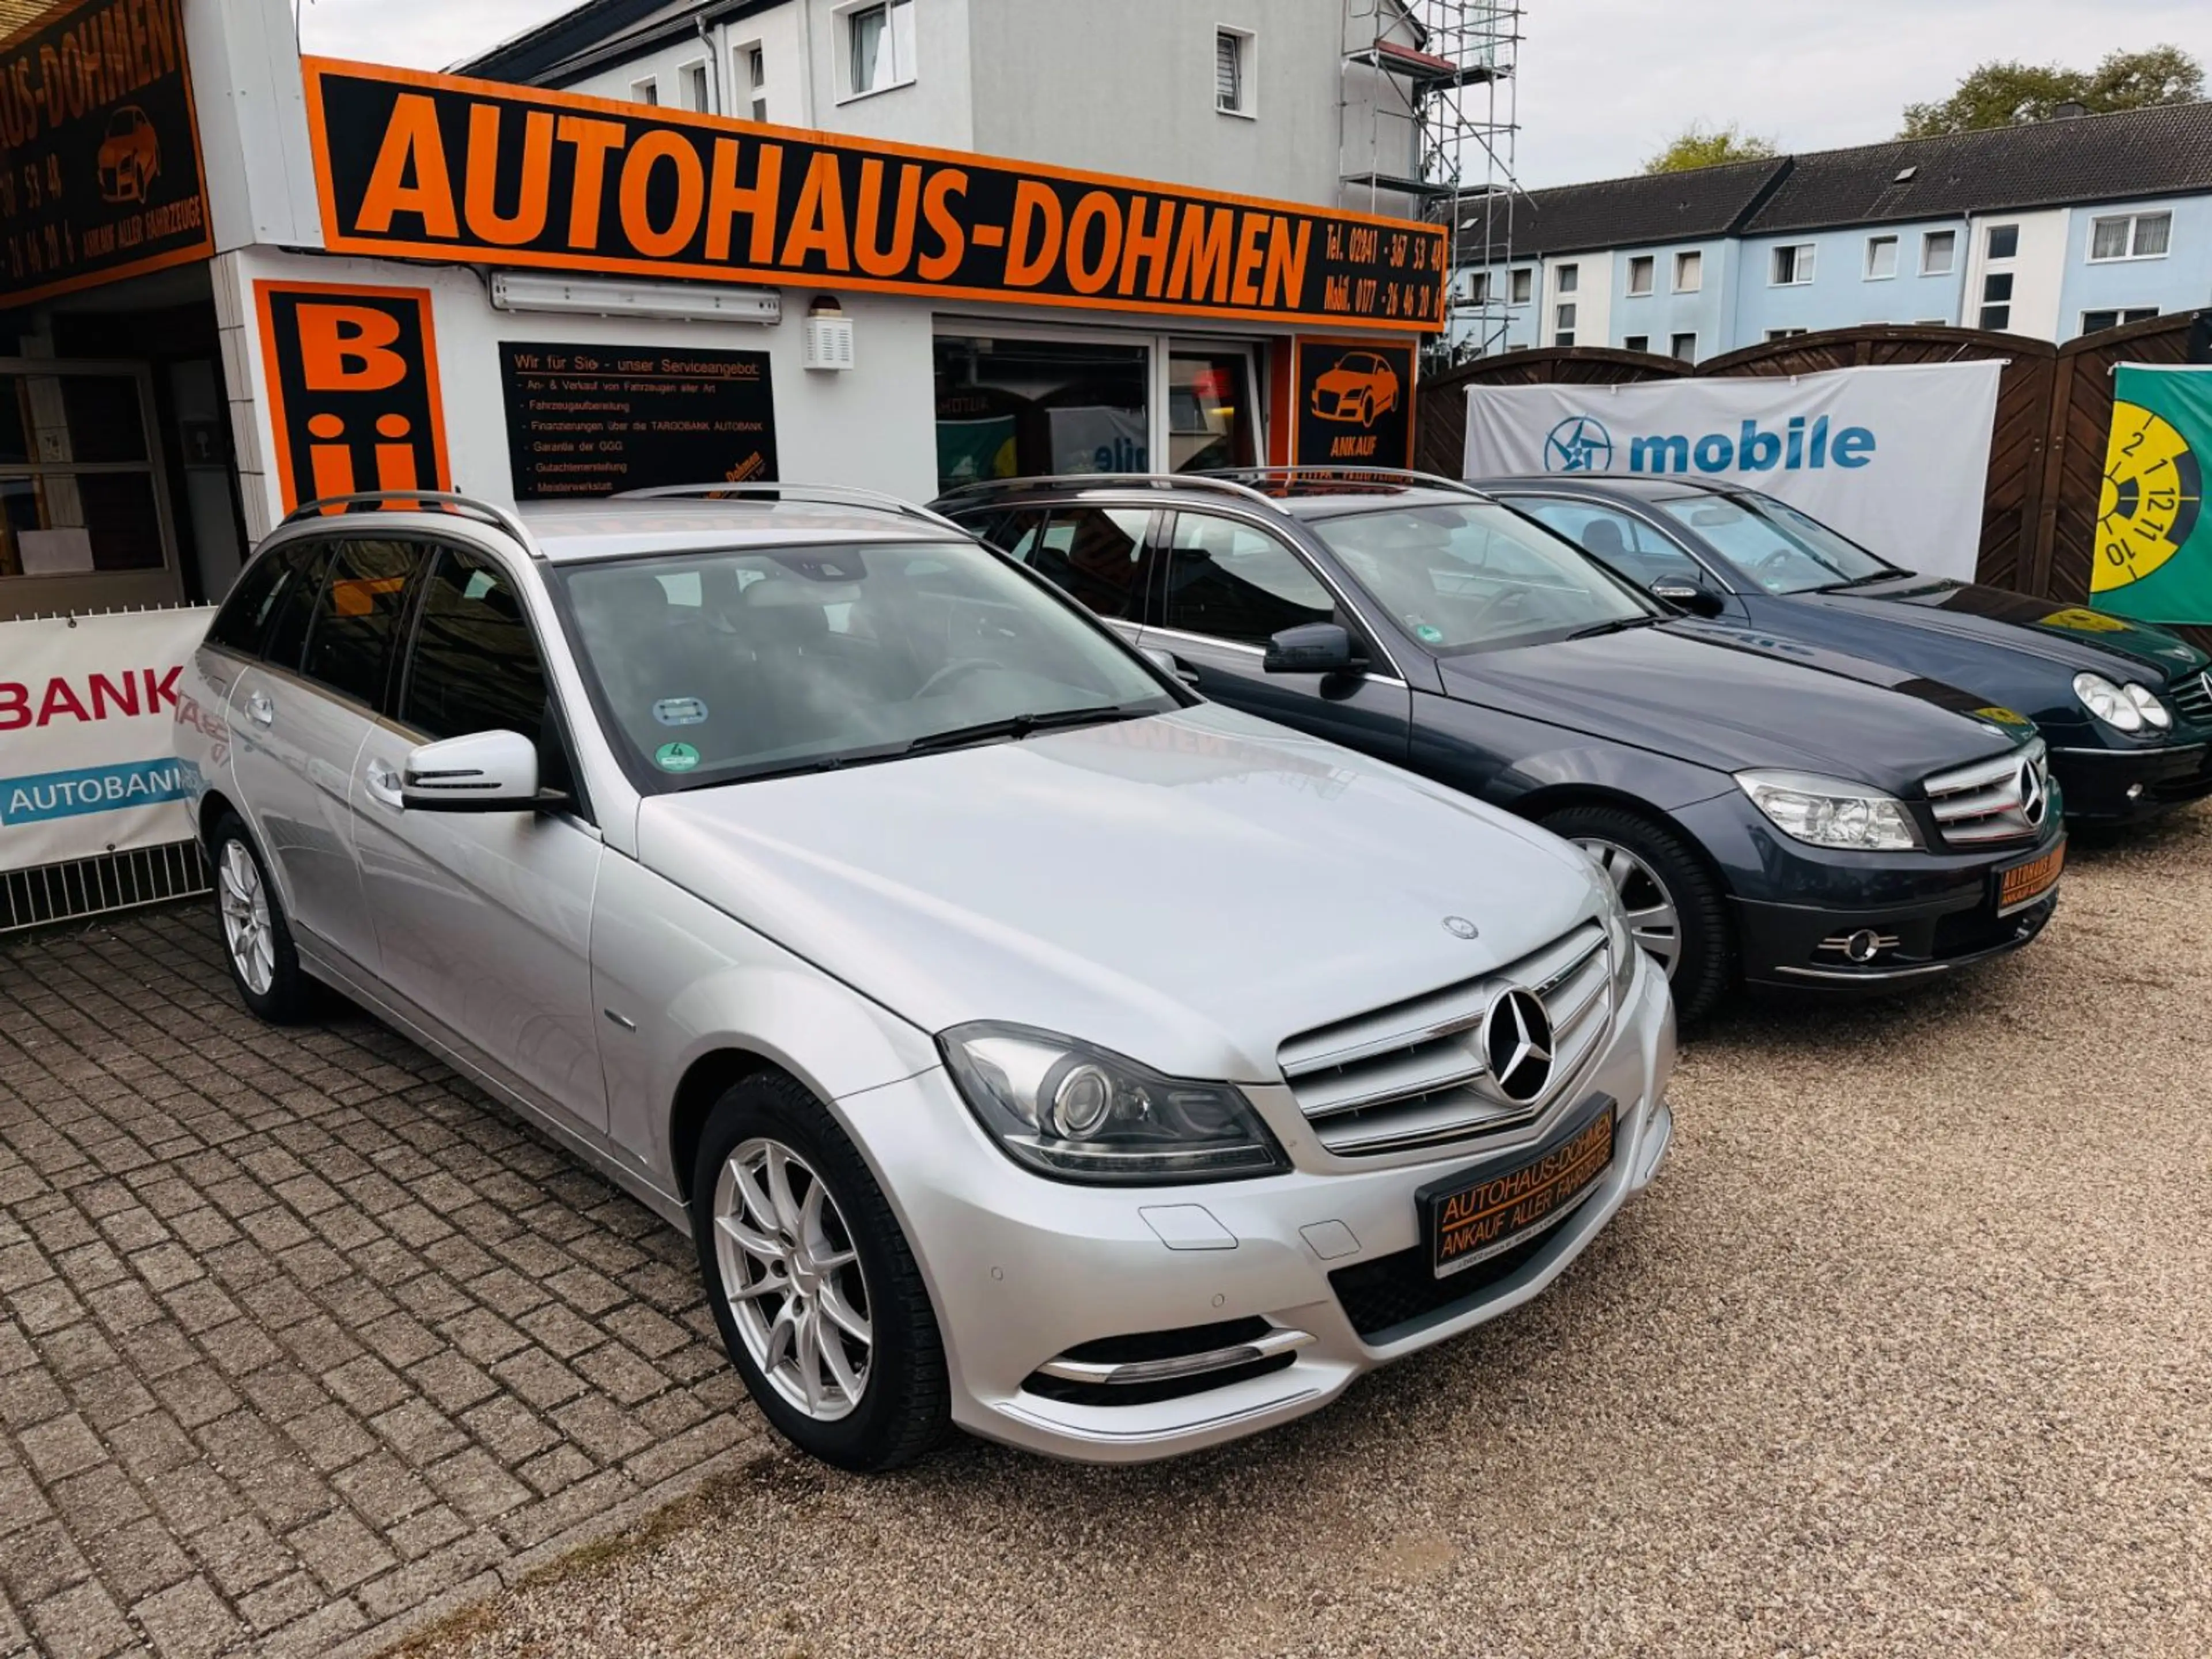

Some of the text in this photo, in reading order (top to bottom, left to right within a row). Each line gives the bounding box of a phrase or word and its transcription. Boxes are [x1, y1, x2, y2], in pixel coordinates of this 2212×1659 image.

[355, 92, 1312, 309] AUTOHAUS-DOHMEN
[1327, 224, 1343, 260] Tel.
[514, 354, 539, 369] Wir
[547, 355, 566, 370] für
[574, 356, 599, 370] Sie
[618, 360, 654, 371] unser
[563, 380, 597, 391] Verkauf
[624, 381, 676, 395] Fahrzeugen
[531, 421, 603, 433] Finanzierungen
[607, 421, 628, 430] über
[714, 421, 763, 431] AUTOBANK
[533, 442, 574, 452] Garantie
[579, 442, 594, 451] der
[1331, 436, 1377, 457] ANKAUF
[1630, 414, 1877, 473] mobile
[2121, 432, 2145, 457] 2
[2143, 459, 2168, 475] 1
[2147, 487, 2175, 512] 12
[2134, 518, 2164, 541] 11
[2105, 538, 2136, 566] 10
[0, 666, 184, 730] BANK
[1441, 1213, 1505, 1258] ANKAUF
[1511, 1188, 1552, 1229] ALLER
